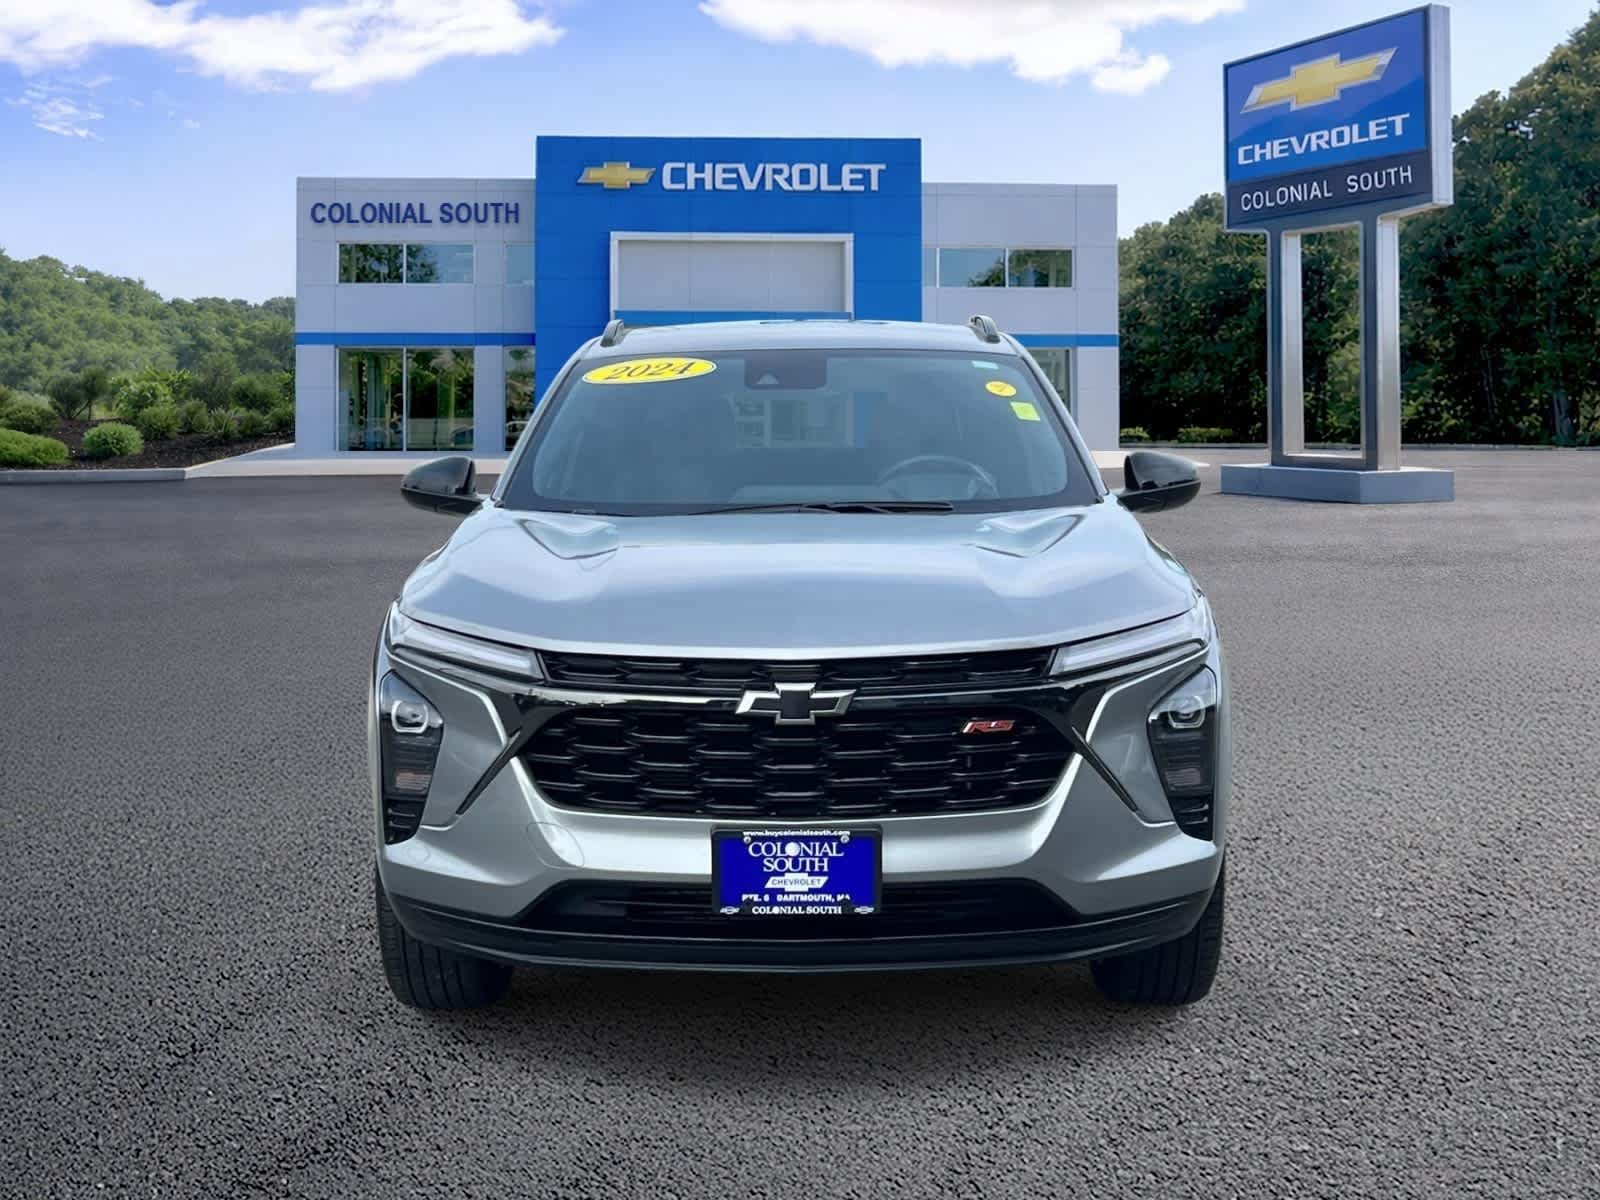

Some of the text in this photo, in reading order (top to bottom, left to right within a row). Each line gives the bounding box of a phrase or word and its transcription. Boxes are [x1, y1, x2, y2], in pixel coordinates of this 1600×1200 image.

[1237, 113, 1410, 165] CHEVROLET
[661, 161, 886, 192] CHEVROLET
[1241, 165, 1413, 211] COLONIAL SOUTH
[310, 202, 520, 225] COLONIAL SOUTH
[605, 361, 696, 380] 2024
[962, 719, 1015, 733] RS
[748, 841, 844, 857] COLONIAL
[763, 857, 829, 872] SOUTH
[771, 878, 822, 886] CHEVROLET
[776, 894, 835, 902] DARTMOUTH,
[751, 906, 842, 914] COLONIAL SOUTH
